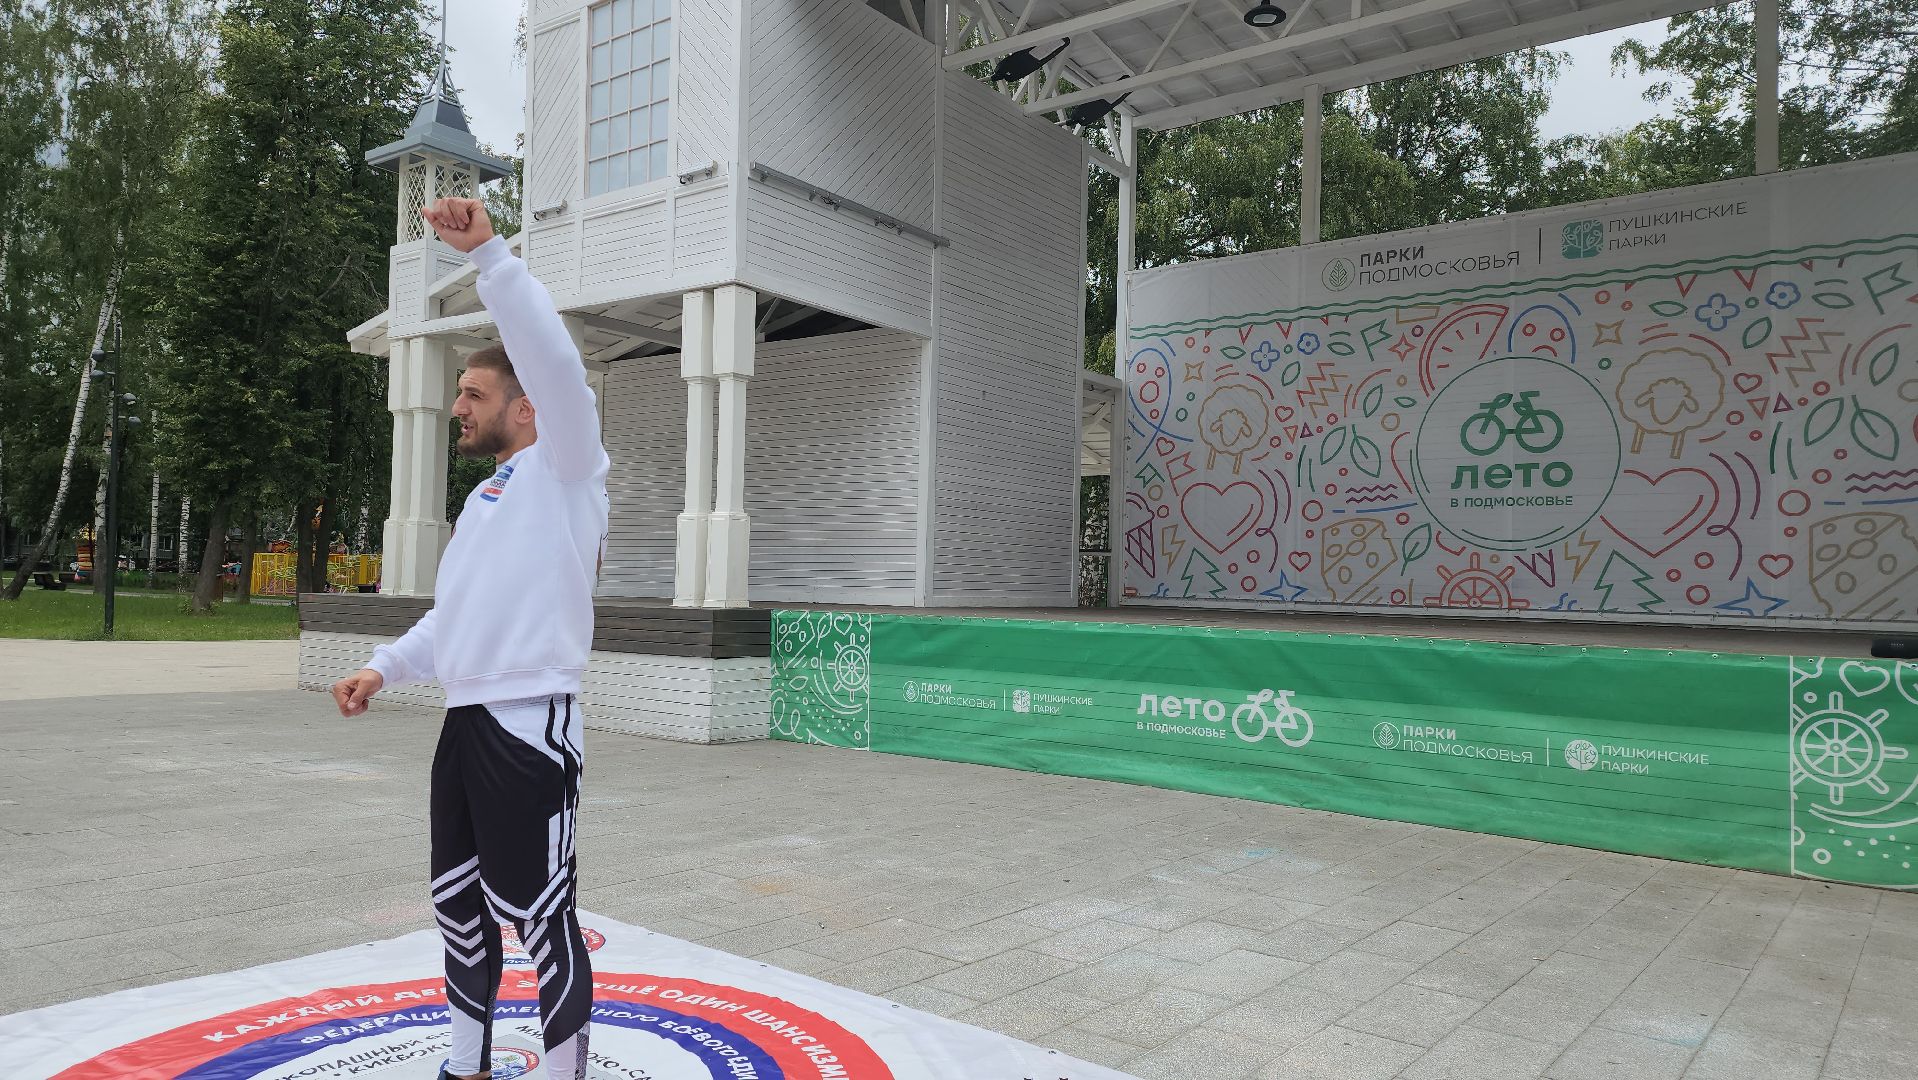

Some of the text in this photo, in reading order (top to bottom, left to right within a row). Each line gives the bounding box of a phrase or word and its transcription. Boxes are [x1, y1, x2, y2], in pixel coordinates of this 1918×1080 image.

[1608, 201, 1748, 233] ПУШКИНСКИЕ
[1608, 232, 1666, 251] ПАРКИ
[1360, 245, 1425, 268] ПАРКИ
[1359, 251, 1521, 286] ПОДМОСКОВЬЯ
[1464, 495, 1574, 510] ПОДМОСКОВЬЕ
[920, 682, 952, 694] ПАРКИ
[920, 693, 996, 710] ПОДМОСКОВЬЯ
[1033, 692, 1093, 706] ПУШКИНСКИЕ
[1033, 704, 1063, 715] ПАРКИ
[1146, 722, 1226, 739] ПОДМОСКОВЬЕ
[1403, 724, 1457, 741] ПАРКИ
[1403, 739, 1533, 764] ПОДМОСКОВЬЯ
[1601, 744, 1710, 765] ПУШКИНСКИЕ
[1601, 760, 1649, 775] ПАРКИ
[202, 994, 384, 1043] КАЖДЫЙ
[658, 988, 748, 1013] ОДИН
[741, 1009, 817, 1045] ШАНС
[300, 1009, 451, 1045] ФЕДЕРАЦИ
[658, 1020, 740, 1056] БОЕВОГО
